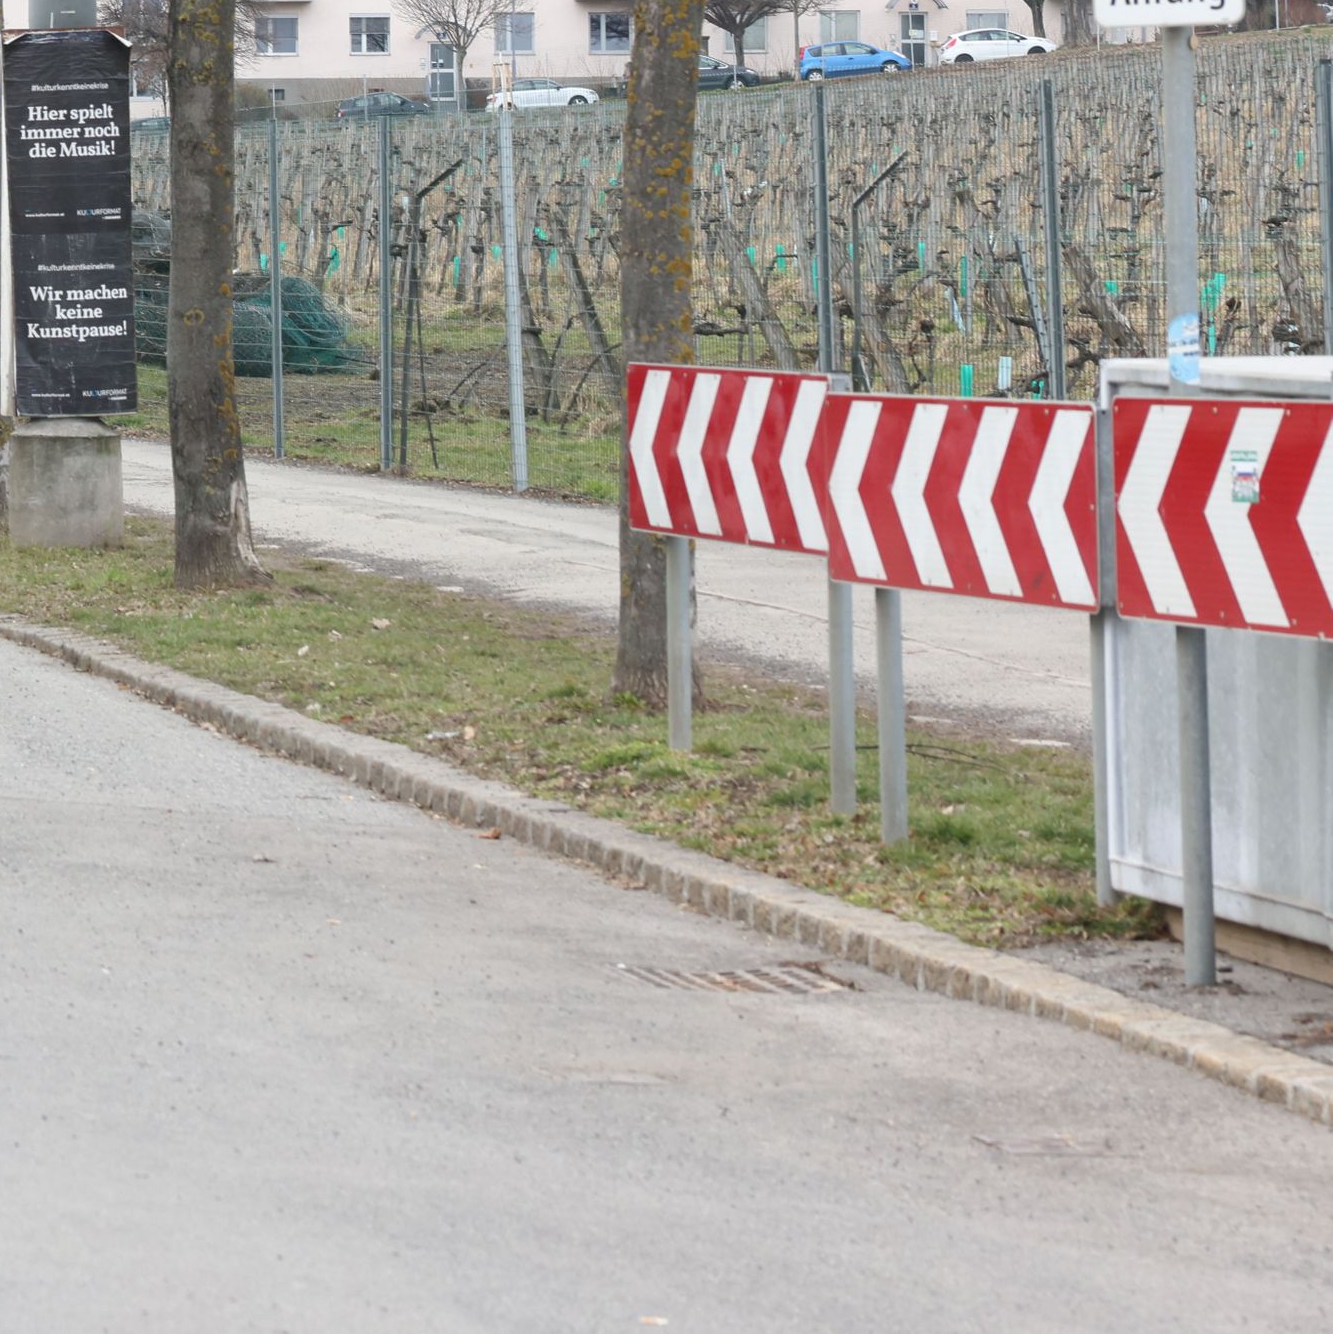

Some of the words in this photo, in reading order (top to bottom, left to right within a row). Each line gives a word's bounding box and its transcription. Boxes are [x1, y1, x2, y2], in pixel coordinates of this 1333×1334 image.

[30, 81, 110, 92] #kulturkenntkeinekrise
[27, 106, 68, 122] Hier
[69, 103, 114, 124] spielt
[20, 124, 81, 140] immer
[83, 122, 120, 138] noch
[28, 142, 57, 158] die
[59, 140, 116, 157] Musik!
[37, 262, 115, 272] #kulturkenntkeinekrise
[29, 285, 64, 301] Wir
[66, 283, 128, 301] machen
[55, 303, 103, 319] keine
[26, 319, 128, 342] Kunstpause!
